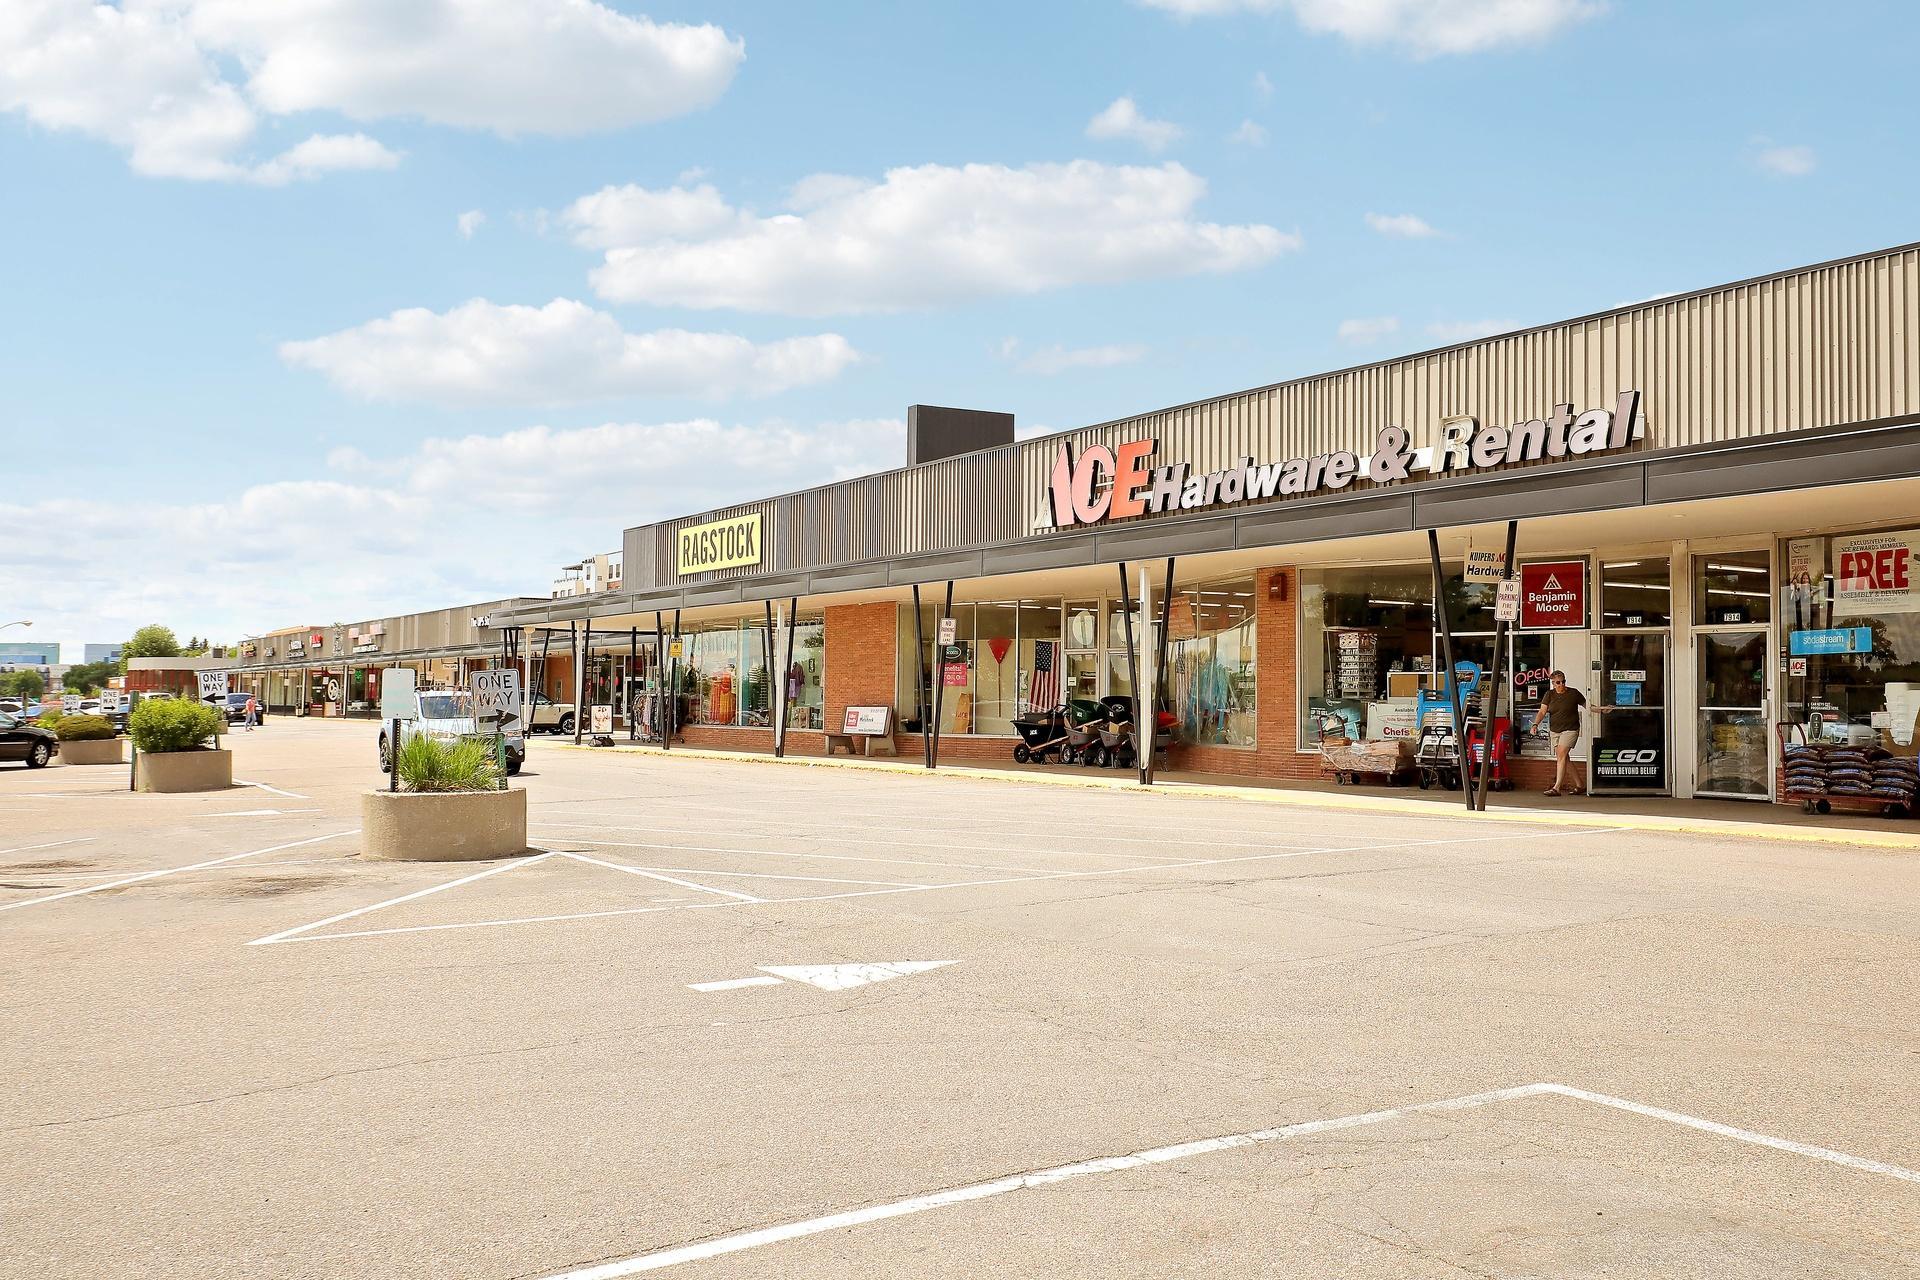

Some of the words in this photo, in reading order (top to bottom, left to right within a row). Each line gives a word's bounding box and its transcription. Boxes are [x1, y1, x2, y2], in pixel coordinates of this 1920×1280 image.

[1033, 438, 1158, 528] ACE
[1151, 456, 1359, 513] Hardware
[1369, 425, 1416, 483] &
[1429, 390, 1640, 474] Rental
[682, 522, 755, 568] RAGSTOCK
[1850, 538, 1883, 546] EXCLUSIVELY
[1851, 544, 1880, 552] REWARDS
[1880, 541, 1907, 549] MEMBERS
[1469, 551, 1495, 562] KUIPERS
[1467, 565, 1514, 576] Hardwae
[1840, 548, 1910, 592] FREE
[1505, 582, 1514, 592] NO
[1499, 593, 1518, 601] PARKING
[1528, 591, 1577, 603] Benjamin
[1840, 591, 1874, 599] ASSEMBLY
[1880, 588, 1910, 597] DELIVERY
[1535, 603, 1569, 612] Moore
[1627, 616, 1642, 624] 7914
[1724, 613, 1741, 621] 7914
[1803, 633, 1844, 645] sodastream
[1791, 662, 1805, 670] ACE
[203, 673, 224, 682] ONE
[1514, 667, 1551, 685] OPEN
[203, 682, 224, 691] WAY
[478, 674, 513, 690] ONE
[479, 691, 513, 706] WAY
[1597, 749, 1657, 763] EGO
[1597, 766, 1618, 775] POWER
[1618, 766, 1639, 775] BEYOND
[1640, 766, 1657, 775] BELIEF
